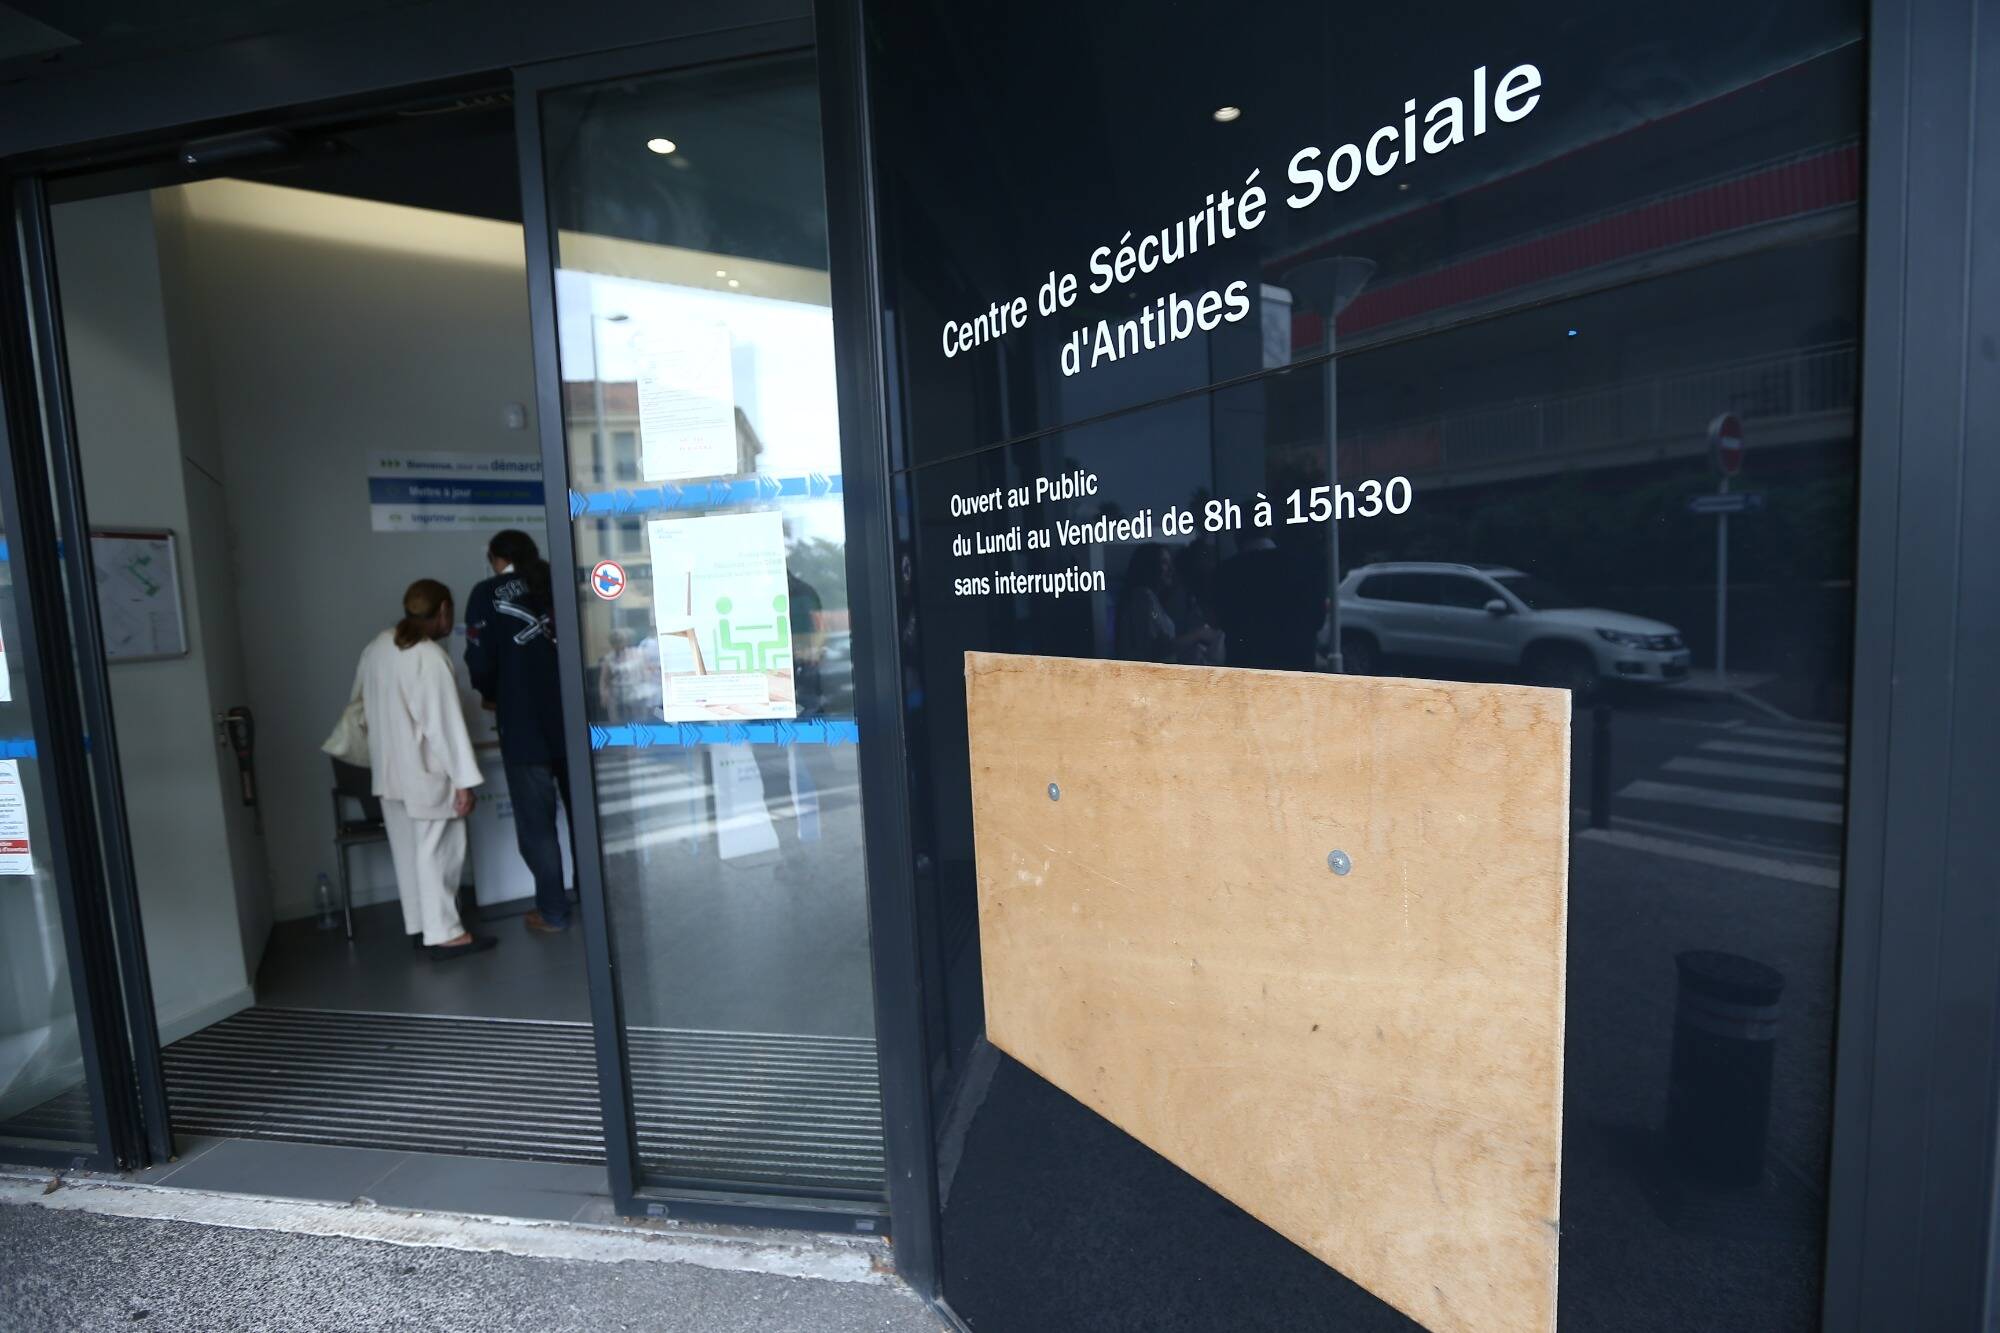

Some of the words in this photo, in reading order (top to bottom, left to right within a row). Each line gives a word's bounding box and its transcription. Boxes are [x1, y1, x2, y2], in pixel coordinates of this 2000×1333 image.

[942, 296, 1028, 359] Centre
[1038, 270, 1078, 317] de
[1089, 167, 1267, 294] Sécurité
[1286, 64, 1542, 209] Sociale
[1061, 280, 1250, 377] d'Antibes
[950, 486, 1003, 518] Ouvert
[1007, 483, 1030, 508] au
[1035, 469, 1098, 504] Public
[952, 533, 972, 557] du
[976, 526, 1022, 555] Lundi
[1027, 528, 1051, 550] au
[1055, 508, 1153, 546] Vendredi
[1161, 505, 1194, 537] de
[1204, 498, 1242, 532] 8h
[1253, 492, 1273, 528] à
[1286, 476, 1412, 525] 15h30
[954, 575, 991, 596] sans
[995, 565, 1106, 599] interruption
